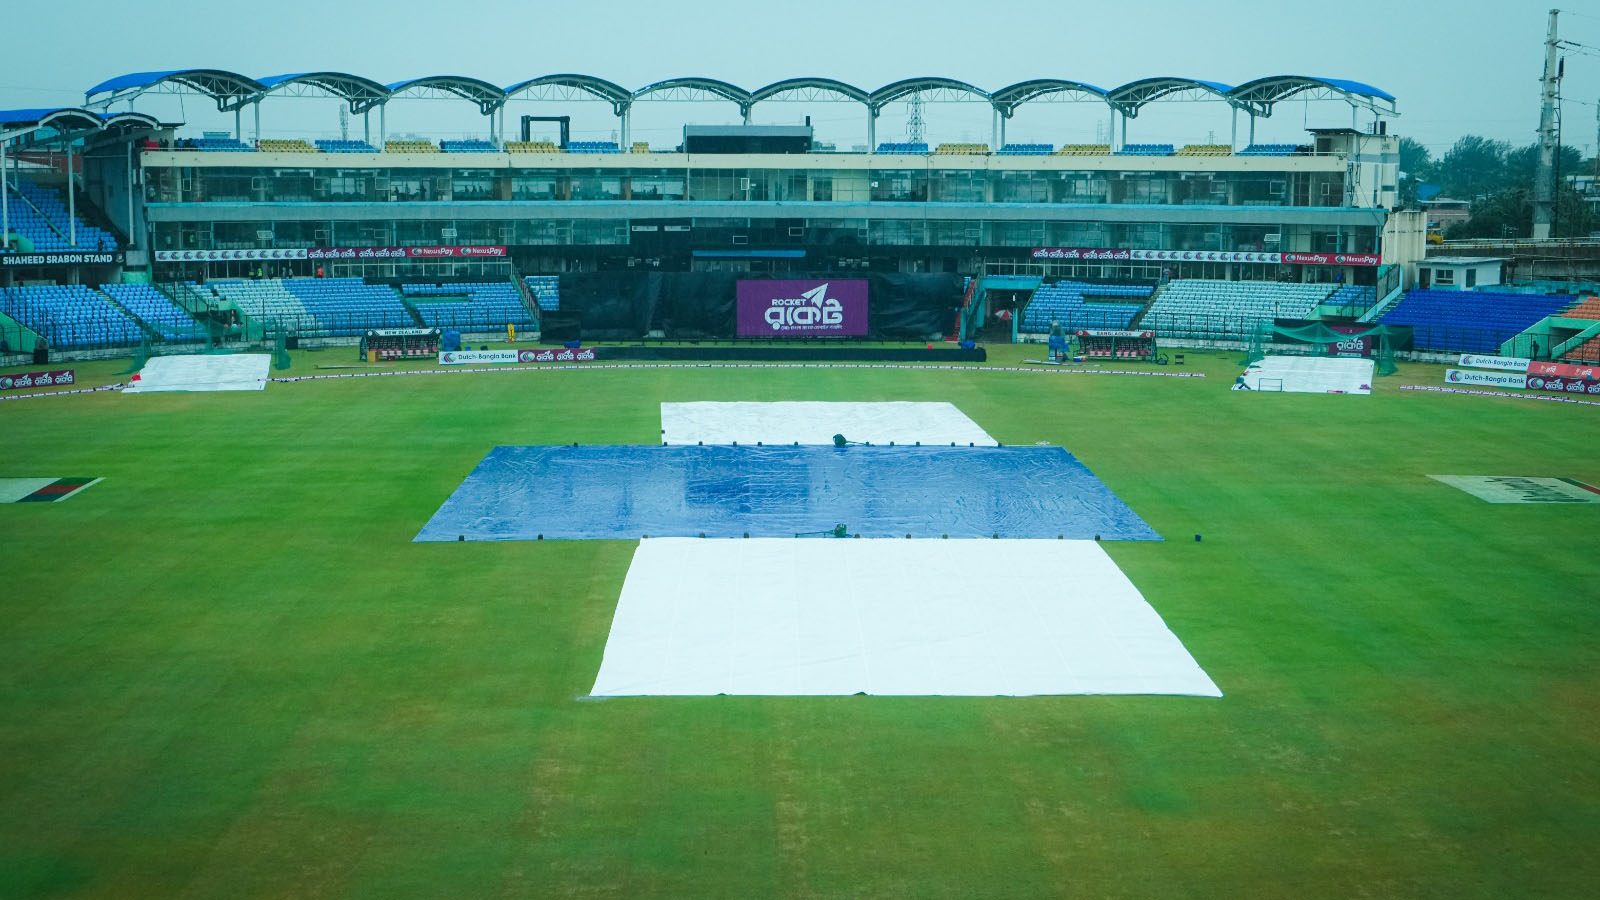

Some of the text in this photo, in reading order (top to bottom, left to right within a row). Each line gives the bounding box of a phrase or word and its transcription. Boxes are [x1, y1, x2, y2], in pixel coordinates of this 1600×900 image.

[423, 247, 454, 256] NexusPay
[472, 247, 503, 256] NexusPay
[2, 254, 113, 265] SHAHEED SRABON STAND
[1296, 254, 1327, 263] NexusPay
[1346, 255, 1377, 265] NexusPay
[771, 298, 807, 306] ROCKET
[1475, 358, 1513, 367] Dutch-Bangla
[1464, 373, 1507, 384] Dutch-Bangla
